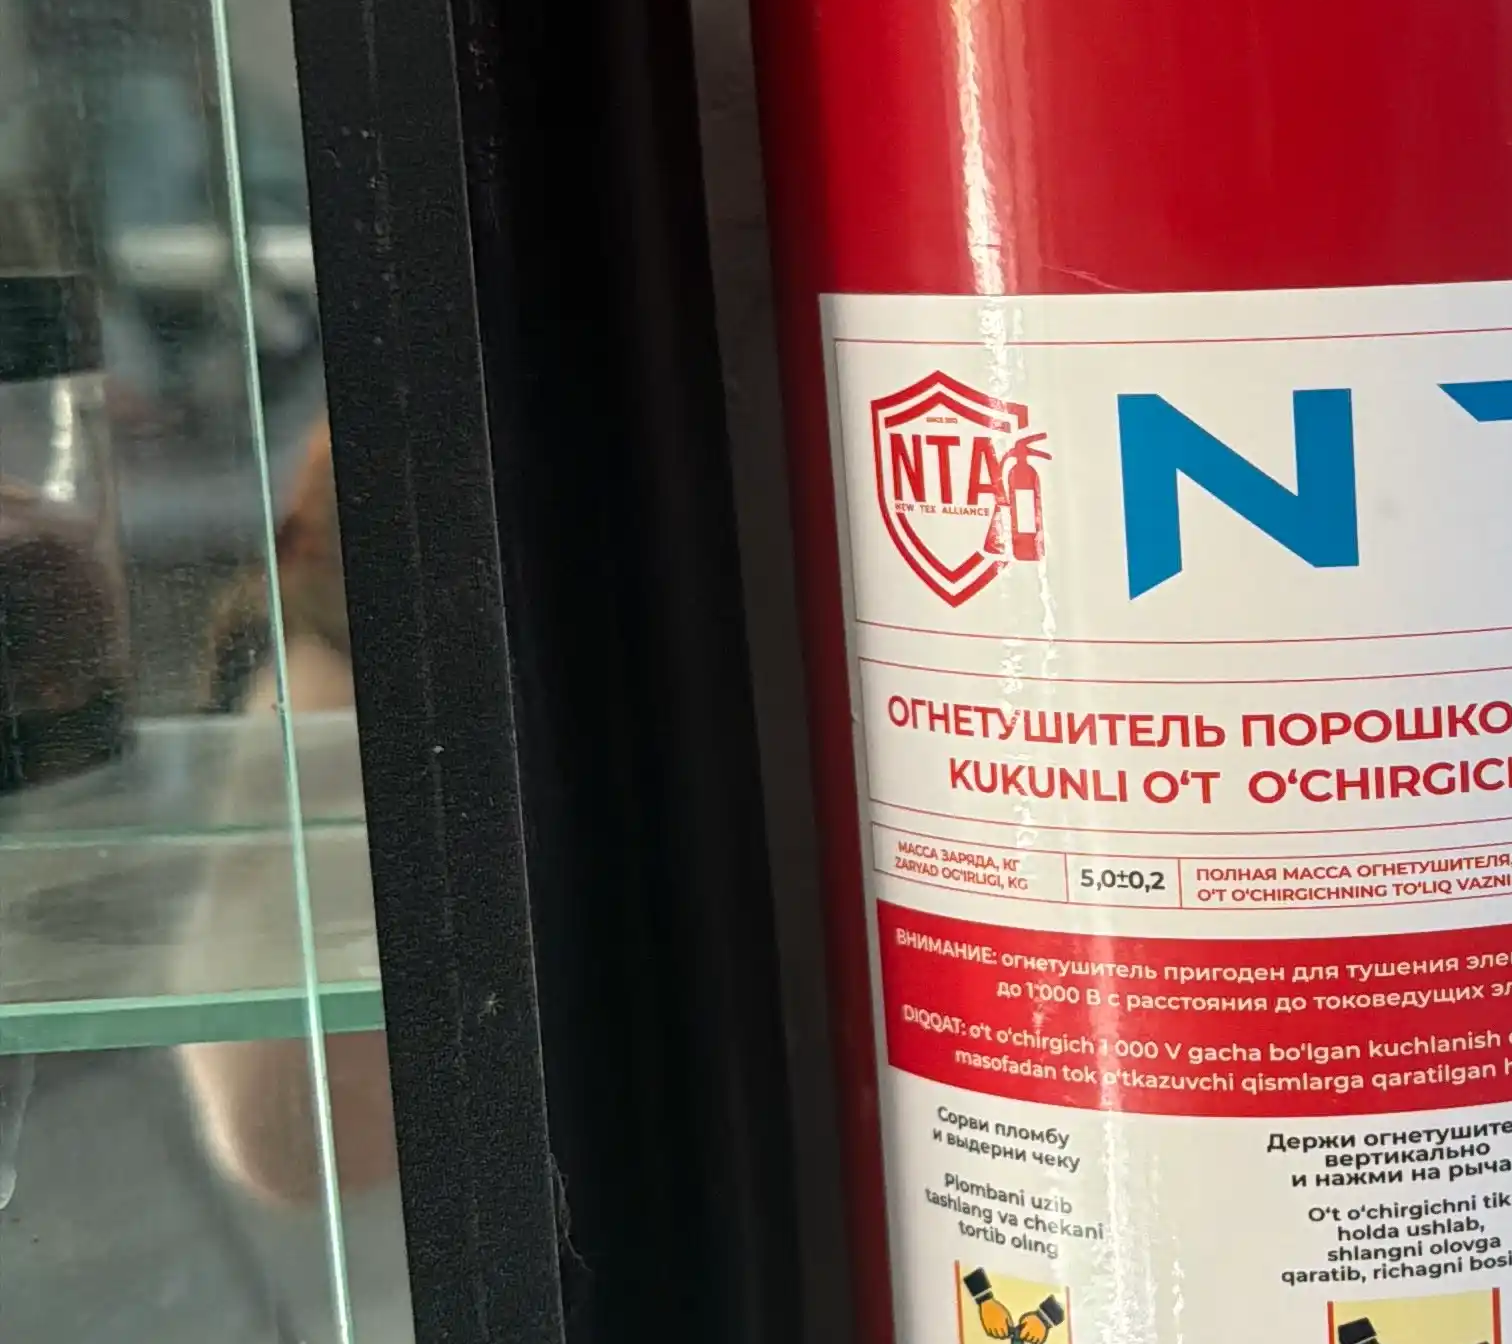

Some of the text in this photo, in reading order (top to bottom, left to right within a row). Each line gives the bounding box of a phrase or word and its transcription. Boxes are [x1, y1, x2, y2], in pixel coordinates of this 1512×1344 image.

[890, 433, 1011, 505] NTA
[942, 507, 989, 516] ALLIANCE
[888, 695, 1225, 748] ОГНЕТУШИТЕЛЬ
[950, 758, 1127, 803] KUKUNLI
[898, 841, 1020, 872] МАССА ЗАРЯДА, КГ
[1008, 876, 1028, 890] KG
[1080, 868, 1165, 892] 5,0±0,2
[1197, 868, 1276, 882] ПОЛНАЯ
[1283, 865, 1352, 881] МАССА
[896, 928, 997, 965] ВНИМАНИЕ:
[1002, 953, 1157, 982] огнетушитель
[1164, 966, 1284, 985] пригоден
[1292, 965, 1338, 983] для
[1346, 957, 1458, 982] тушения
[997, 981, 1021, 999] до
[1127, 994, 1267, 1012] расстояния
[1275, 997, 1306, 1013] до
[1313, 984, 1484, 1010] токоведущих
[903, 1004, 966, 1036] DIQQAT:
[1188, 1043, 1261, 1065] gacha
[1369, 1030, 1500, 1058] kuchlanish
[956, 1050, 1056, 1080] masofadan
[1062, 1065, 1097, 1084] tok
[1242, 1072, 1363, 1095] qismlarga
[1372, 1064, 1496, 1091] qaratilgan
[938, 1106, 1069, 1149] Сорви пломбу
[947, 1133, 1026, 1162] выдерни
[1032, 1151, 1080, 1173] чеку
[1267, 1133, 1355, 1153] Держи
[1326, 1143, 1490, 1170] вертикально
[945, 1172, 1024, 1206] Plombani
[1316, 1170, 1402, 1187] нажми
[1412, 1166, 1440, 1181] на
[925, 1188, 992, 1225] tashlang
[998, 1211, 1018, 1227] va
[1483, 1191, 1511, 1209] tik
[958, 1220, 1005, 1245] tortib
[1338, 1216, 1484, 1242] holda ushlab,
[1328, 1236, 1501, 1262] shlangni olovga
[1282, 1265, 1366, 1286] qaratib,
[1374, 1256, 1462, 1280] richagni
